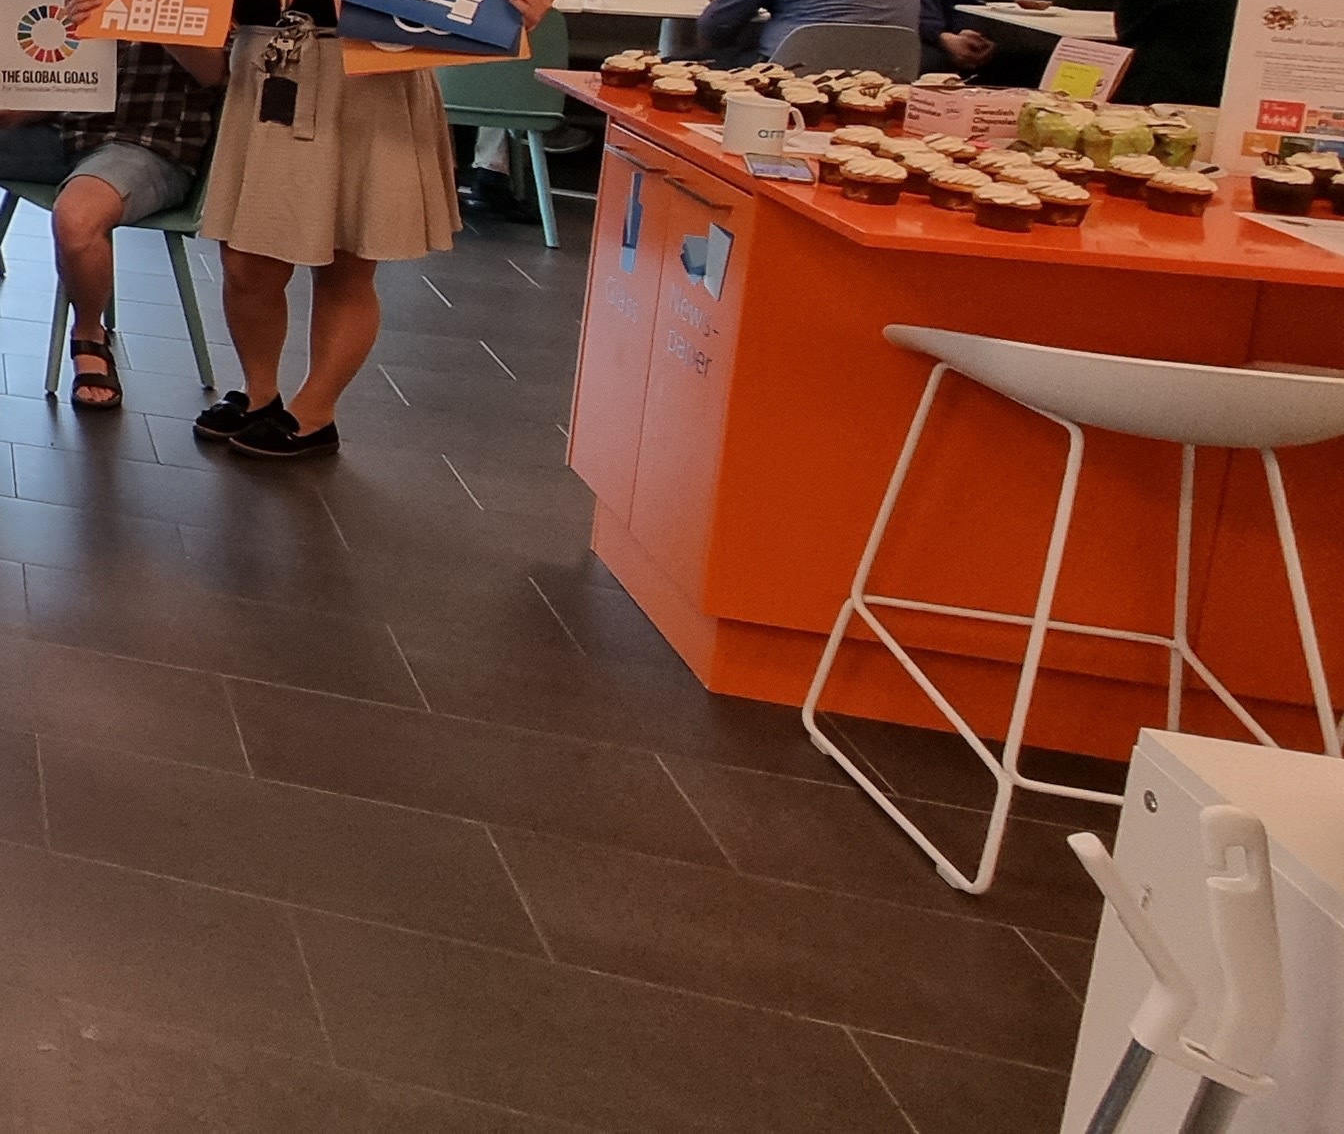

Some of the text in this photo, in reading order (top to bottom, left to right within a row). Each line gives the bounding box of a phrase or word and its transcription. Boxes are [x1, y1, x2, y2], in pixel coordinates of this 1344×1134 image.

[1, 70, 99, 85] THE GLOBAL GOALS
[973, 108, 1015, 116] Swedish
[972, 116, 1017, 125] Chocolat
[757, 129, 785, 139] arm
